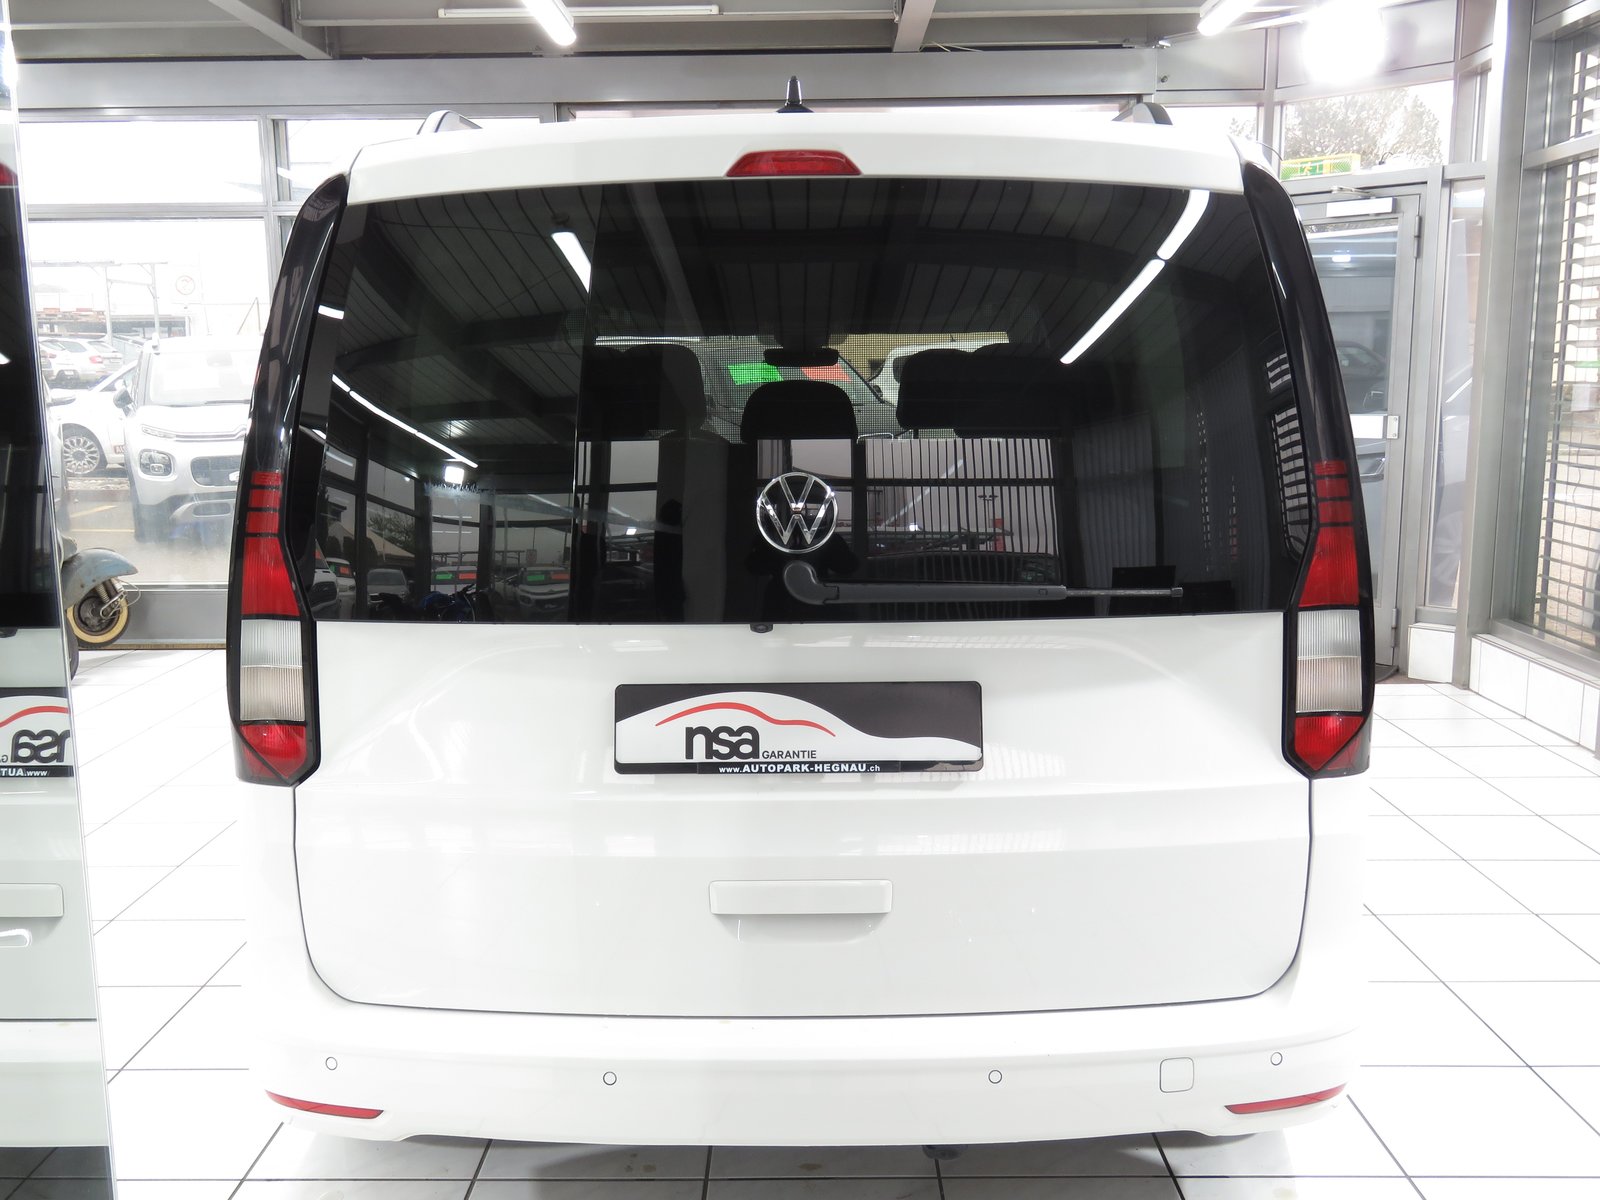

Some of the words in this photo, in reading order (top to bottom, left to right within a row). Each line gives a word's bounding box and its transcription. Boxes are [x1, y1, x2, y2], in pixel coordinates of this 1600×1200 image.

[760, 475, 836, 546] VW
[685, 726, 760, 760] nsa
[762, 750, 817, 759] GARANTIE
[718, 763, 881, 773] www.AUTOPARK-HEGNAU.ch
